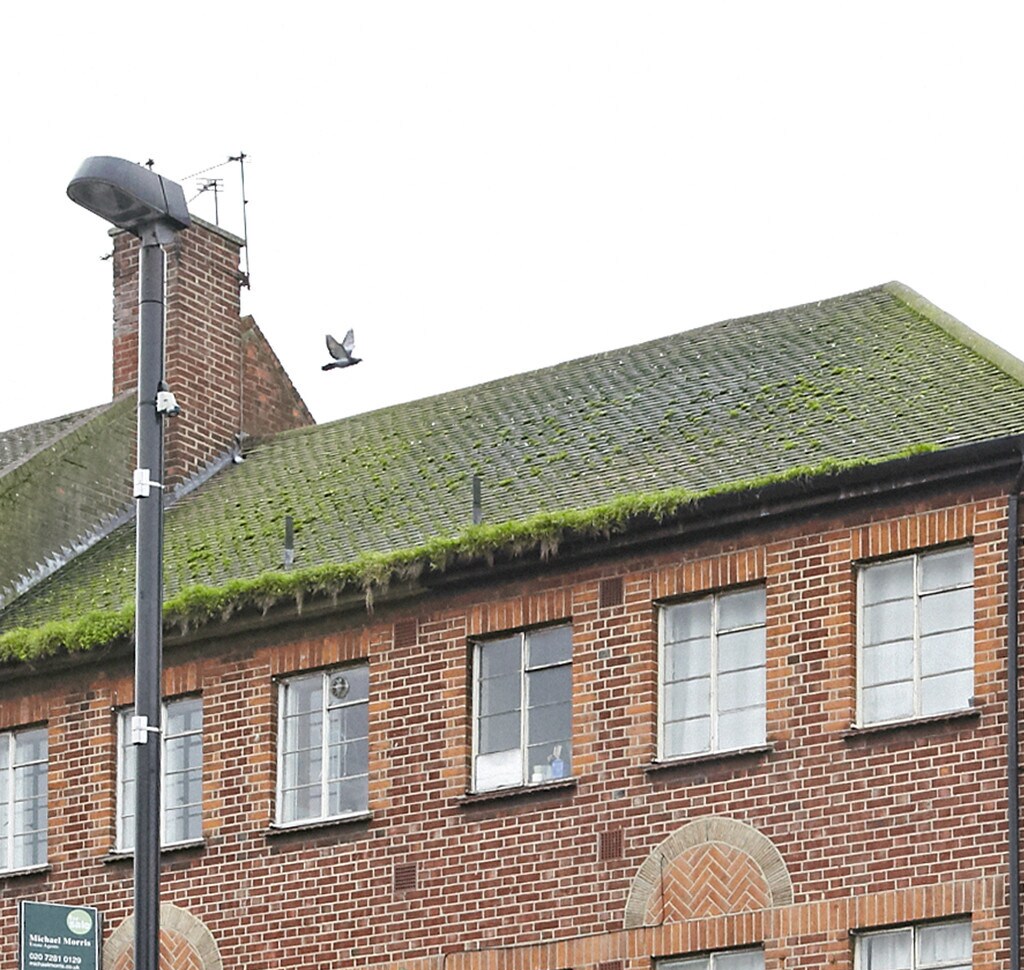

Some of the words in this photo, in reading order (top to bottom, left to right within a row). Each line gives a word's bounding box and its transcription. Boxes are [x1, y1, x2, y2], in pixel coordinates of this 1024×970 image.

[29, 934, 61, 944] Michael
[63, 937, 91, 947] Morris
[29, 952, 43, 961] 020
